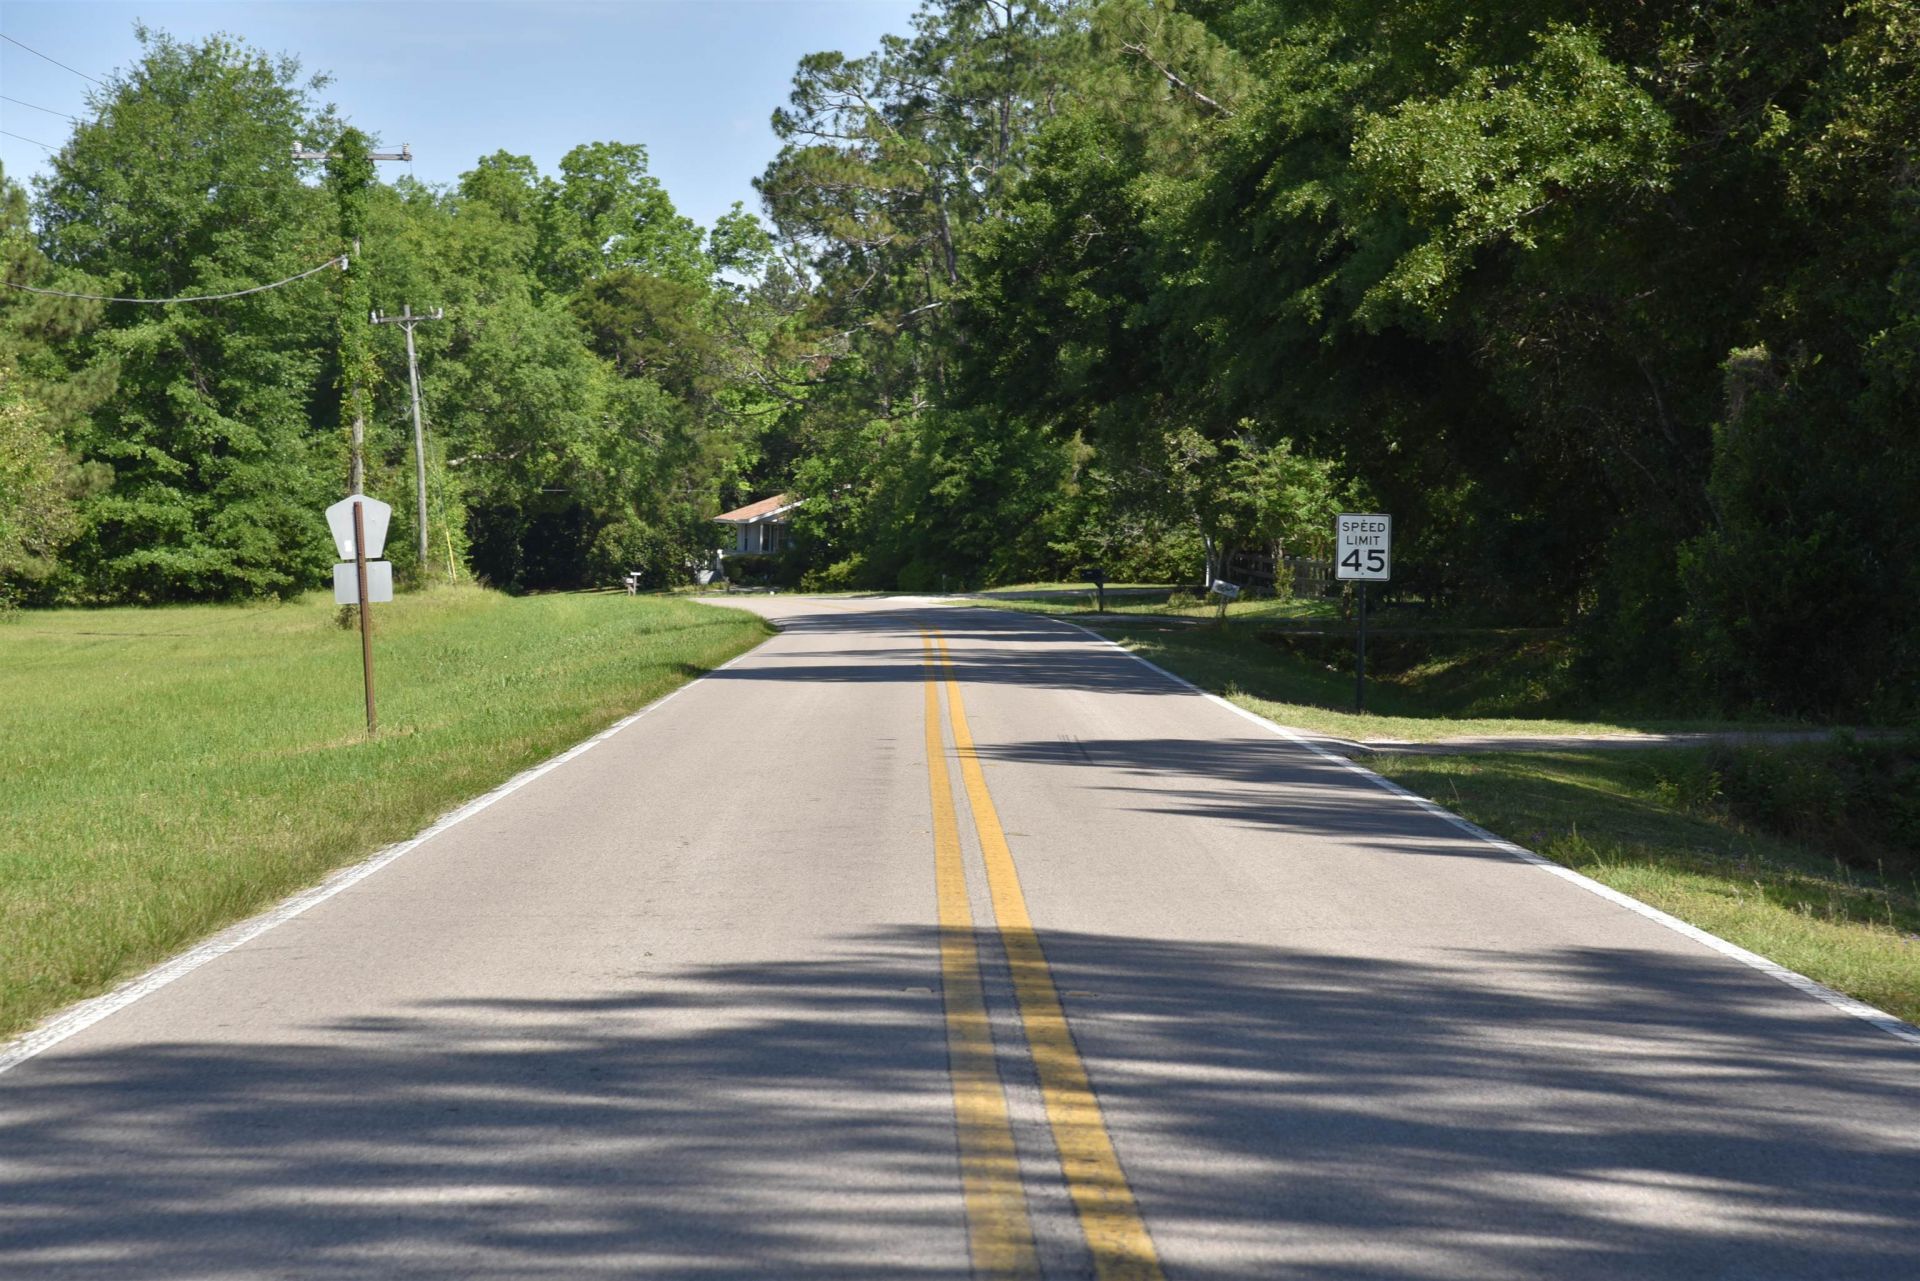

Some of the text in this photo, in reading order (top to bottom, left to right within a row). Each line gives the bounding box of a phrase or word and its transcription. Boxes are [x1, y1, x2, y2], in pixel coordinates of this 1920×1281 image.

[1342, 522, 1385, 532] SPEED
[1346, 536, 1380, 545] LIMIT
[1341, 549, 1385, 572] 45
